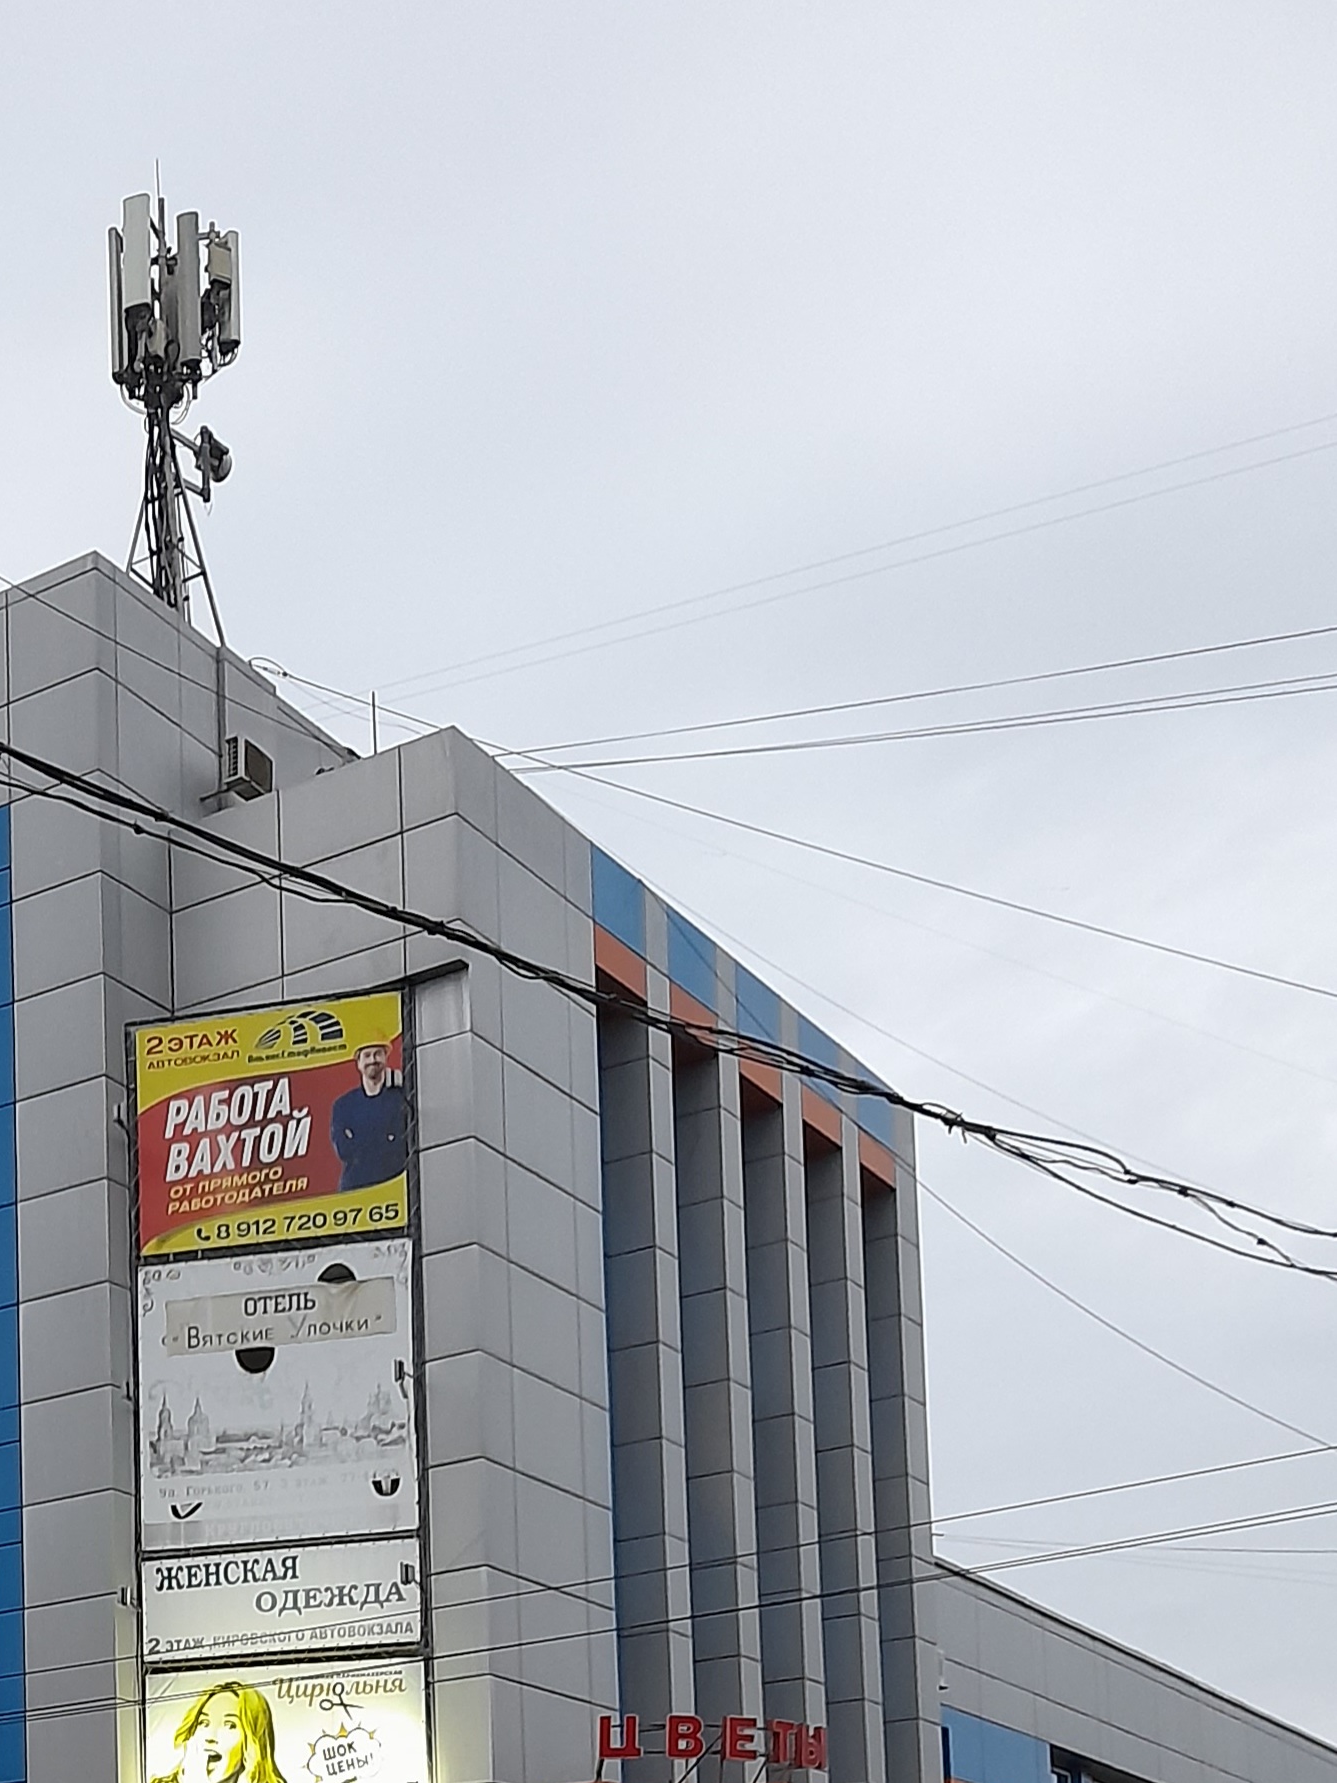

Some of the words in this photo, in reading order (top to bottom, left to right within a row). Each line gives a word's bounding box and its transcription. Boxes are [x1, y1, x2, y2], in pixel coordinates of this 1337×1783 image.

[146, 1035, 164, 1056] 2
[167, 1028, 239, 1053] ЭТАЖ
[147, 1050, 240, 1070] АВТОВОКЗАЛ
[164, 1077, 291, 1139] РАБОТА
[165, 1106, 312, 1182] ВАХТОЙ
[167, 1177, 308, 1215] РАБОТОДАТЕЛЯ
[169, 1183, 195, 1200] ОТ
[198, 1166, 283, 1195] ПРЯМОГО
[216, 1225, 231, 1240] 8
[237, 1218, 276, 1237] 912
[283, 1212, 327, 1233] 720
[332, 1208, 362, 1227] 97
[368, 1203, 400, 1222] 65
[243, 1291, 317, 1316] ОТЕЛЬ
[155, 1555, 299, 1591] ЖЕНСКАЯ
[254, 1581, 407, 1617] ОДЕЖДА
[147, 1637, 161, 1655] 2
[309, 1621, 414, 1640] АВТОВОКЗАЛА
[322, 1741, 357, 1761] ШОК
[598, 1714, 829, 1770] ЦВЕТЫ
